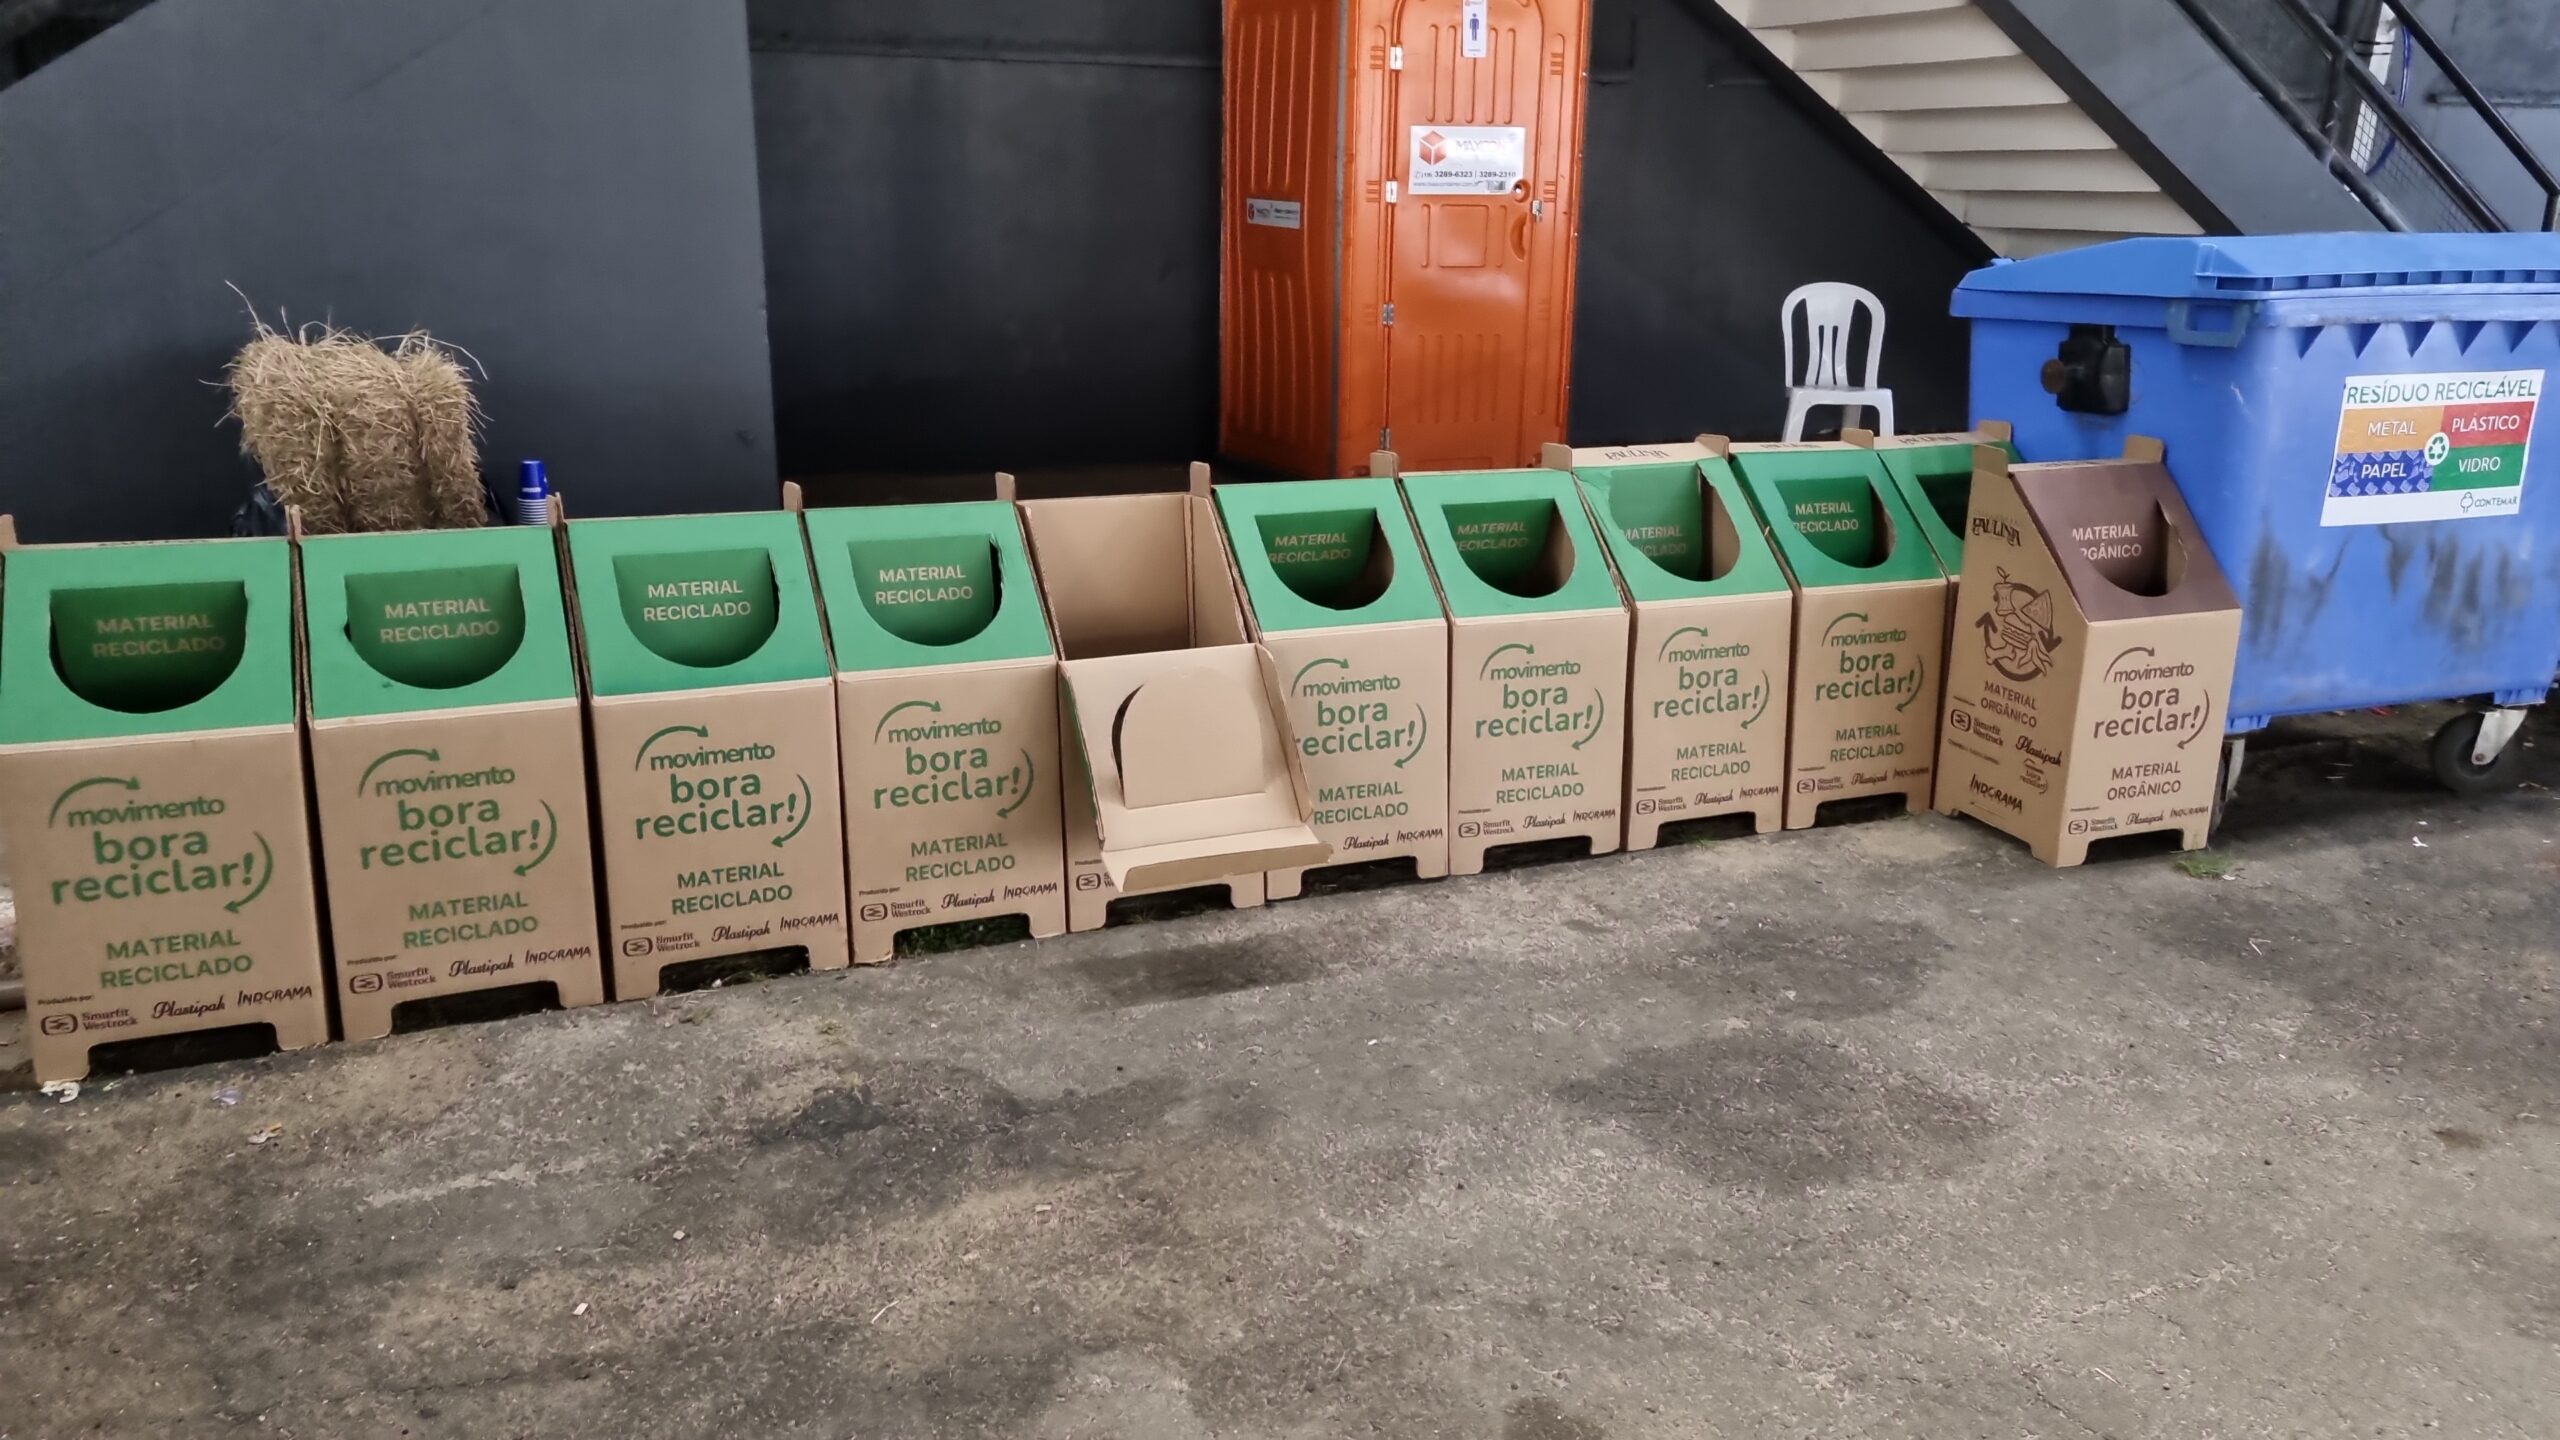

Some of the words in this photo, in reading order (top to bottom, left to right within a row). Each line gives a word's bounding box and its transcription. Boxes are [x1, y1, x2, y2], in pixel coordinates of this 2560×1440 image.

[1435, 170, 1473, 178] 3289-6323
[2346, 379, 2429, 404] RESÍDUO
[2435, 375, 2536, 400] RECICLÁVEL
[2367, 420, 2417, 436] METAL
[2452, 412, 2520, 433] PLÁSTICO
[2361, 463, 2407, 478] PAPEL
[2458, 456, 2501, 473] VIDRO
[1795, 501, 1854, 515] MATERIAL
[2475, 495, 2518, 508] CONTEMAR
[1275, 533, 1348, 547] MATERIAL
[1457, 522, 1528, 535] MATERIAL
[2072, 523, 2139, 541] MATERIAL
[1456, 537, 1529, 551] ECICLADO
[2080, 543, 2142, 560] GÂNICO
[879, 565, 966, 583] MATERIAL
[648, 580, 743, 598] MATERIAL
[875, 586, 974, 605] RECICLADO
[384, 598, 490, 619] MATERIAL
[643, 601, 752, 622] RECICLADO
[96, 613, 214, 634] MATERIAL
[380, 620, 500, 643] RECICLADO
[92, 636, 226, 658] RECICLADO
[1831, 628, 1906, 647] movimento
[1668, 642, 1750, 664] movimento
[1840, 650, 1895, 675] bora
[1490, 660, 1581, 681] movimento
[1679, 666, 1738, 691] bora
[2113, 661, 2194, 683] movimento
[1303, 674, 1400, 698] movimento
[1502, 683, 1568, 710] bora
[1815, 669, 1915, 702] reciclar!
[1984, 680, 2037, 711] MATERIAL
[1653, 685, 1760, 719] reciclar!
[2120, 686, 2180, 711] bora
[1317, 700, 1388, 727] bora
[1475, 704, 1593, 739] reciclar!
[1980, 697, 2037, 728] ORGÂNICO
[2093, 705, 2200, 739] reciclar!
[888, 717, 1002, 743] movimento
[1296, 720, 1415, 756] eciclar!
[1836, 723, 1901, 742] MATERIAL
[651, 742, 776, 771] movimento
[906, 746, 988, 775] bora
[1676, 741, 1747, 761] MATERIAL
[1830, 742, 1904, 763] RECICLADO
[2015, 735, 2062, 767] Plastipak
[376, 766, 515, 797] movimento
[1501, 762, 1580, 782] MATERIAL
[1671, 760, 1750, 782] RECICLADO
[2112, 761, 2181, 781] MATERIAL
[670, 773, 761, 804] bora
[873, 766, 1021, 809] reciclar!
[1319, 781, 1403, 803] MATERIAL
[1496, 782, 1584, 804] RECICLADO
[1969, 774, 2023, 814] INDORAMA
[2107, 780, 2181, 800] ORGÂNICO
[68, 796, 225, 827] movimento
[398, 799, 500, 831] bora
[635, 793, 797, 840] reciclar!
[1314, 801, 1409, 826] RECICLADO
[1522, 813, 1566, 829] Plastipak
[1572, 809, 1616, 822] INDORAMA
[93, 830, 208, 864] bora
[360, 819, 542, 871] reciclar!
[911, 832, 1009, 857] MATERIAL
[1343, 833, 1390, 851] Plastipak
[1396, 827, 1443, 843] INDORAMA
[52, 852, 255, 905] reciclar!
[677, 862, 784, 889] MATERIAL
[905, 854, 1016, 882] RECICLADO
[409, 891, 529, 921] MATERIAL
[672, 884, 793, 915] RECICLADO
[891, 899, 926, 910] Smurfit
[941, 888, 995, 910] Plastipak
[1003, 882, 1057, 901] INDORAMA
[892, 907, 931, 918] Westrock
[403, 916, 539, 949] RECICLADO
[656, 931, 694, 944] Smurfit
[711, 920, 771, 942] Plastipak
[780, 912, 840, 932] INDORAMA
[106, 929, 241, 960] MATERIAL
[657, 940, 700, 952] Westrock
[100, 955, 253, 989] RECICLADO
[386, 967, 430, 980] Smurfit
[449, 954, 514, 978] Plastipak
[525, 946, 591, 965] INDORAMA
[388, 976, 437, 989] Westrock
[82, 1008, 130, 1020] Smurfit
[152, 995, 225, 1020] Plastipak
[237, 986, 312, 1007] INDORAMA
[83, 1017, 138, 1031] Westrock
